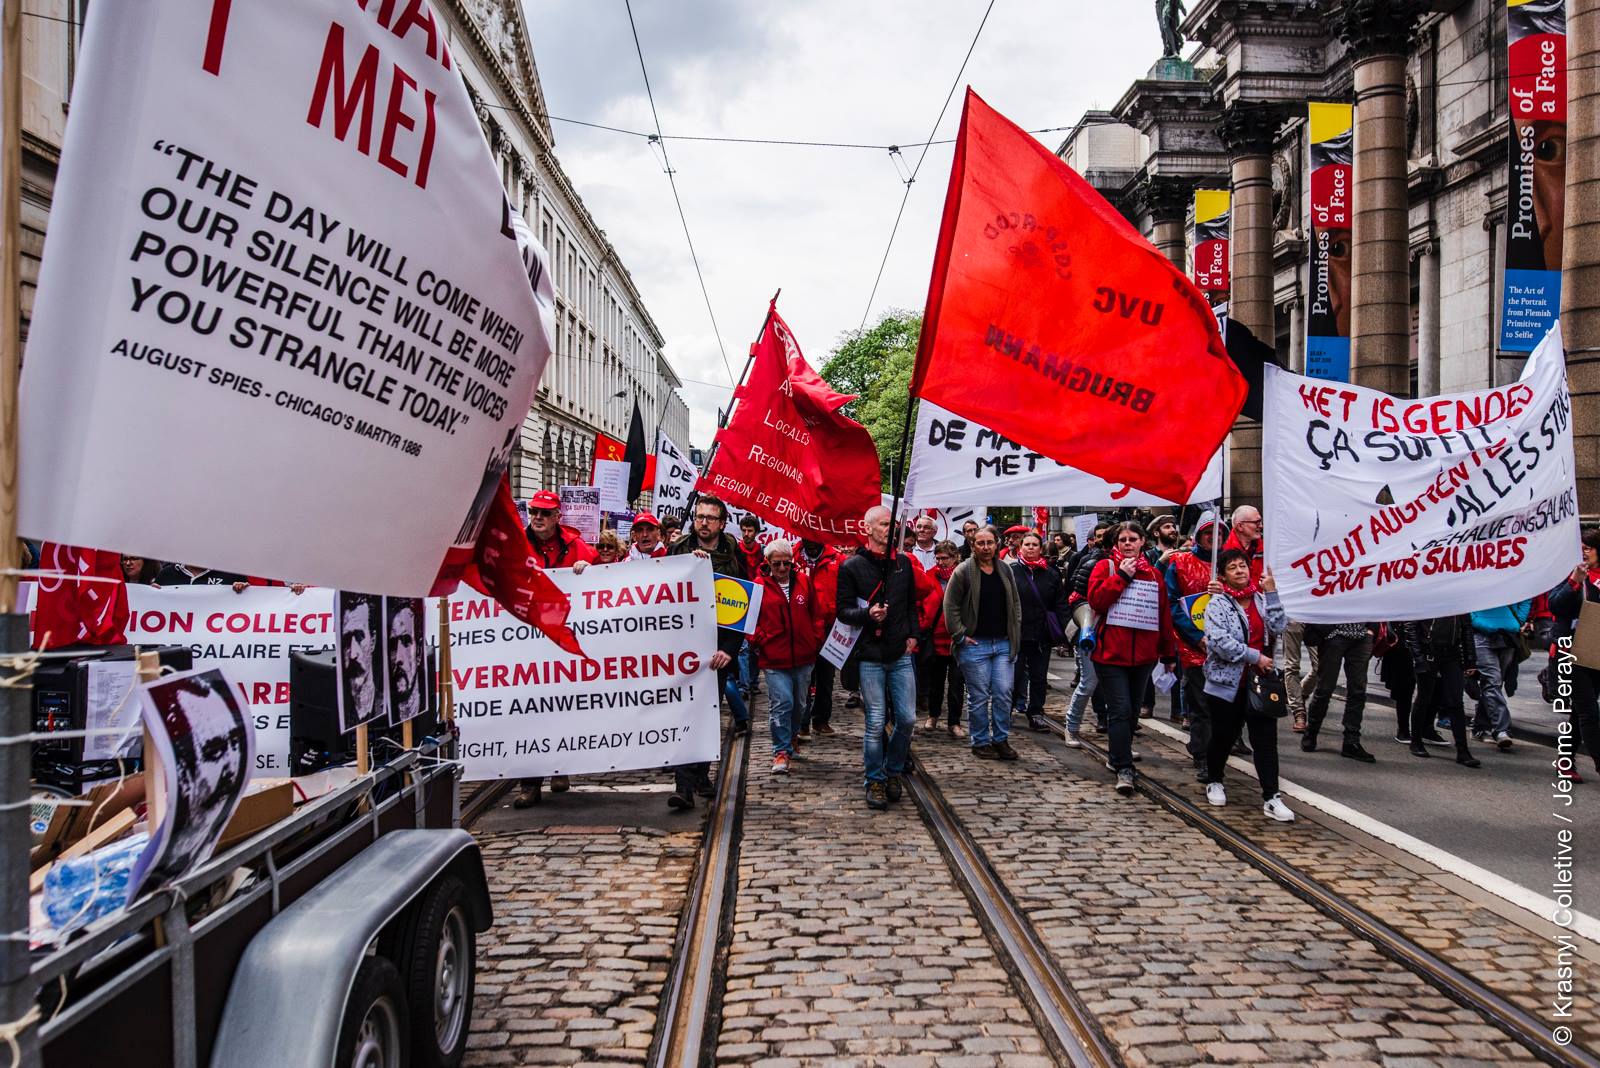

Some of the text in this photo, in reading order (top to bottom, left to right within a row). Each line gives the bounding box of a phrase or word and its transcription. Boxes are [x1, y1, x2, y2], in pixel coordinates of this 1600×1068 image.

[1535, 40, 1556, 113] a Face
[1512, 87, 1535, 240] Promises of
[1330, 168, 1345, 223] a Face
[264, 191, 341, 244] DAY
[346, 228, 408, 286] WILL
[416, 270, 480, 325] COME
[479, 307, 524, 354] WHEN
[1197, 270, 1210, 286] of
[1210, 242, 1223, 286] a Face
[1312, 204, 1330, 316] Promises of
[141, 187, 516, 388] OUR SILENCE WILL BE MORE
[1508, 297, 1547, 306] the Portrait
[1509, 286, 1545, 295] The Art of
[130, 231, 508, 422] POWERFUL THAN THE VOICES
[1506, 319, 1542, 328] Primitives
[1507, 308, 1552, 317] from Flemish
[131, 277, 223, 335] YOU
[229, 316, 398, 405] STRANGLE
[1514, 331, 1534, 339] Selfie
[110, 339, 207, 378] AUGUST
[208, 367, 263, 397] SPIES
[354, 419, 401, 449] MARTYR
[400, 436, 422, 457] 1886
[1298, 384, 1358, 422] HET
[1371, 397, 1400, 433] IS
[928, 418, 967, 451] DE
[1306, 419, 1360, 471] ÇA
[669, 464, 693, 483] DE
[975, 452, 1045, 479] MET
[1453, 431, 1540, 525] ALLES
[659, 484, 681, 500] NOS
[713, 473, 754, 499] REGION
[756, 491, 773, 508] DE
[775, 496, 868, 537] BRUXELLES
[1290, 524, 1367, 579] TOUT
[1310, 536, 1528, 597] SAUF NOS SALAIRES
[582, 581, 700, 611] TRAVAIL
[205, 612, 335, 635] COLLECT
[191, 643, 281, 659] SALAIRE
[452, 651, 700, 691] VERMINDERING
[509, 687, 682, 715] AANWERVINGEN
[515, 738, 551, 755] HAS
[557, 731, 633, 752] ALREADY
